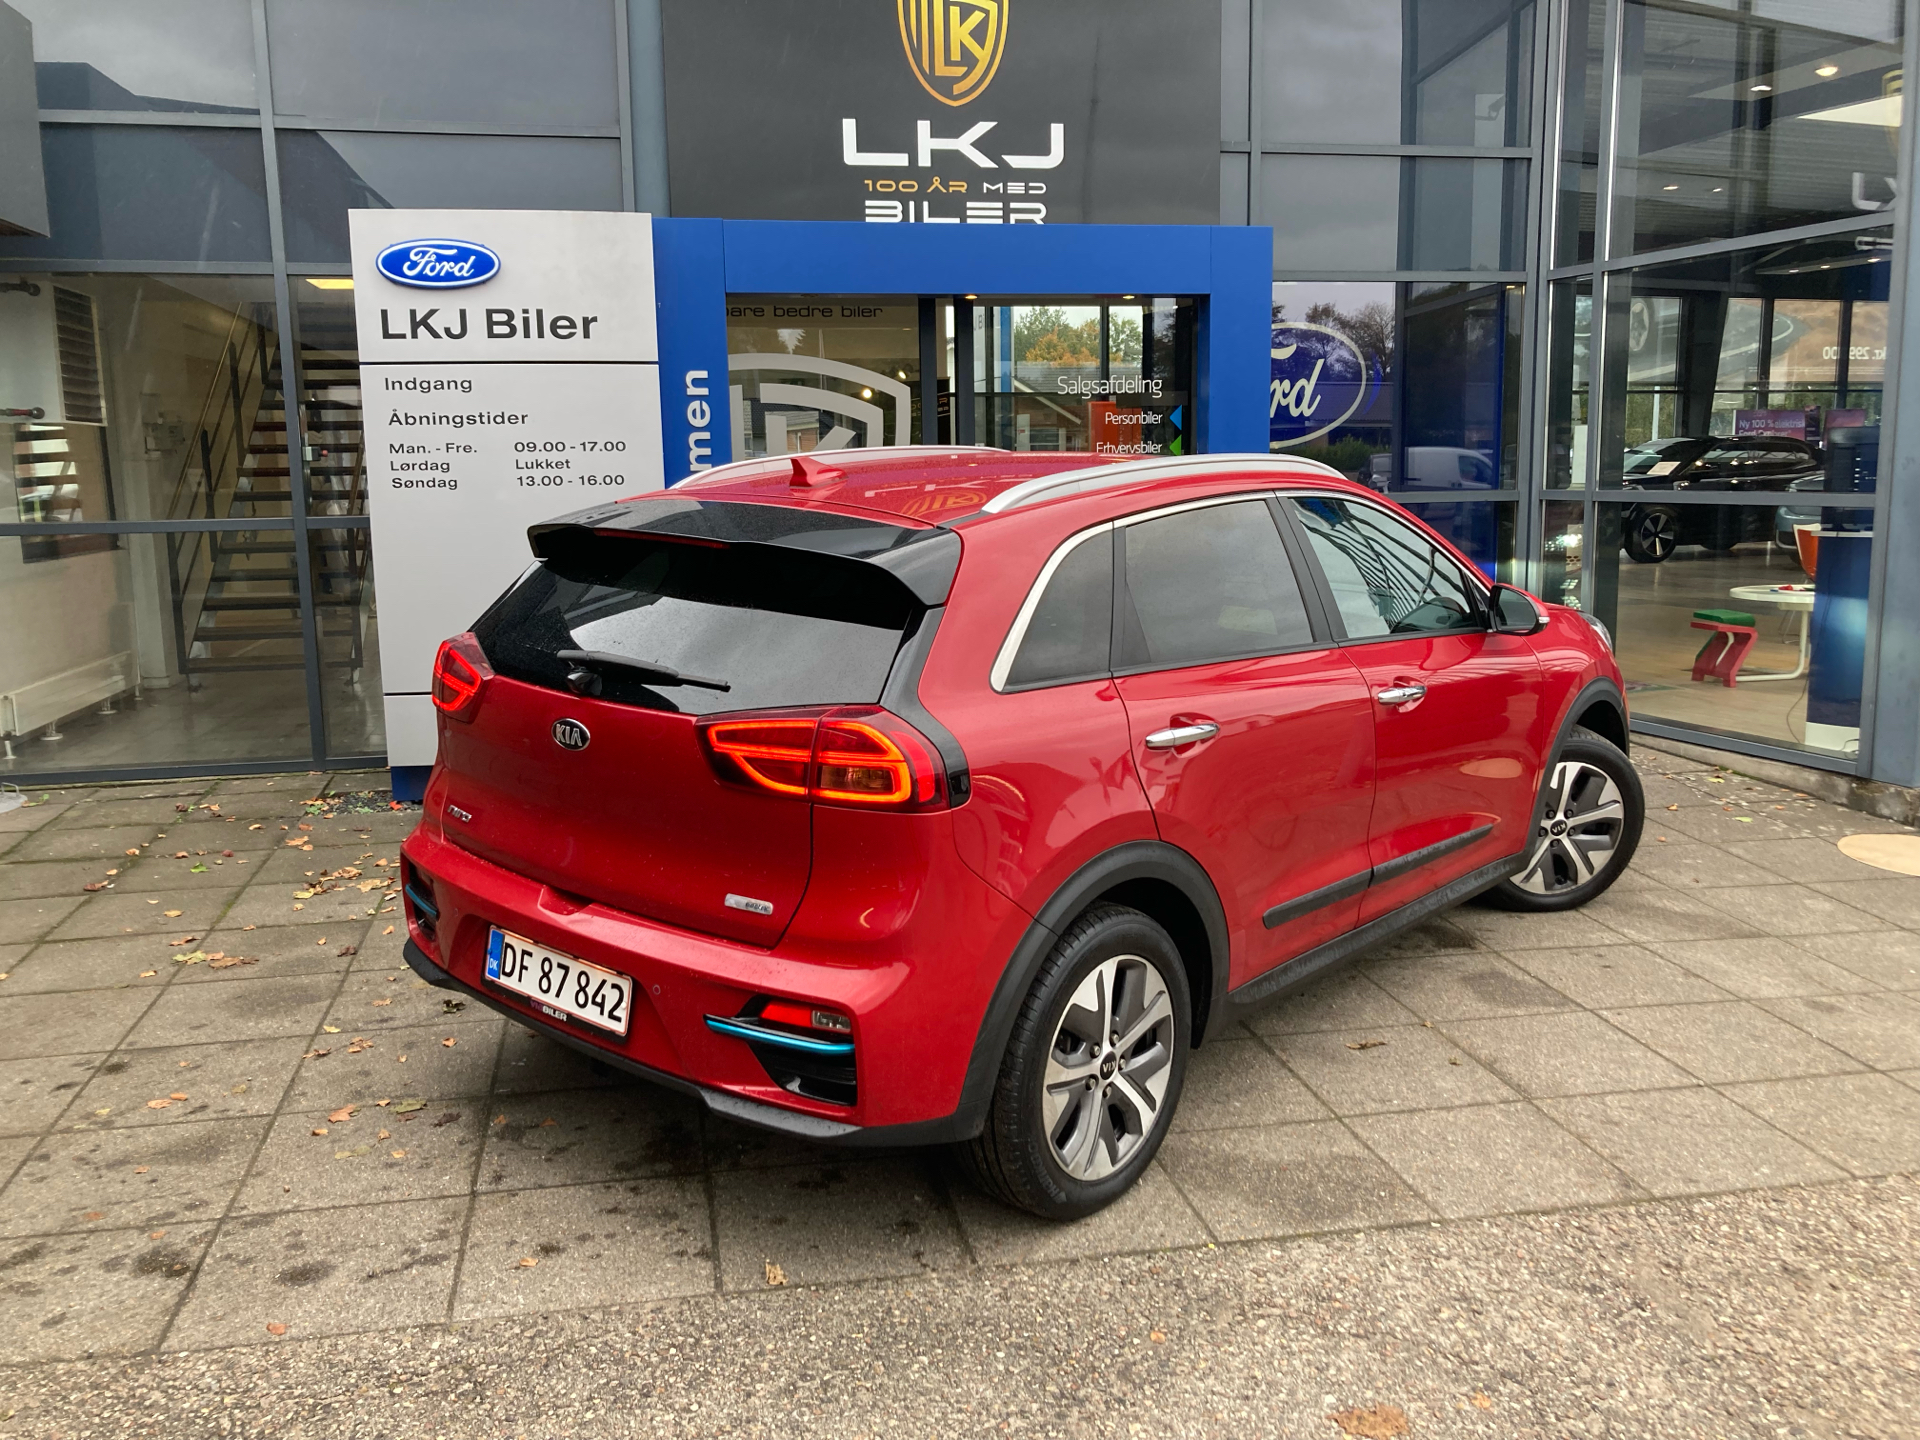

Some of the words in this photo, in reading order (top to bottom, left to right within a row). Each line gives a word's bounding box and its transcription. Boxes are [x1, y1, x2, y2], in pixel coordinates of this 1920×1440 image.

[842, 118, 1065, 169] LKJ
[864, 179, 919, 193] 100
[927, 176, 968, 193] ÅR
[983, 182, 1047, 194] MED
[865, 200, 1047, 225] BILER
[402, 247, 476, 277] Ford
[773, 305, 833, 318] bedre
[841, 305, 883, 318] biler
[380, 308, 468, 340] LKJ
[485, 308, 598, 340] Biler
[384, 377, 473, 394] Indgang
[1057, 375, 1163, 399] Salgsafdeling
[1270, 343, 1325, 418] rd
[388, 408, 529, 429] Åbningstider
[1105, 411, 1163, 425] Personbiler
[1739, 419, 1750, 430] Ny
[1752, 419, 1766, 428] 100
[388, 443, 431, 454] Man.
[445, 442, 478, 454] Fre.
[514, 441, 566, 453] 09.00
[579, 440, 627, 452] 17.00
[1096, 441, 1163, 454] Erhvervsbiler
[390, 460, 450, 473] Lørdag
[515, 458, 571, 470] Lukket
[391, 477, 458, 490] Søndag
[516, 475, 564, 487] 13.00
[578, 474, 625, 486] 16.00
[555, 723, 583, 747] KIA
[489, 958, 498, 971] DK
[501, 941, 533, 983] DF
[538, 956, 570, 998] 87
[574, 970, 625, 1023] 842
[1102, 1060, 1116, 1073] KIA
